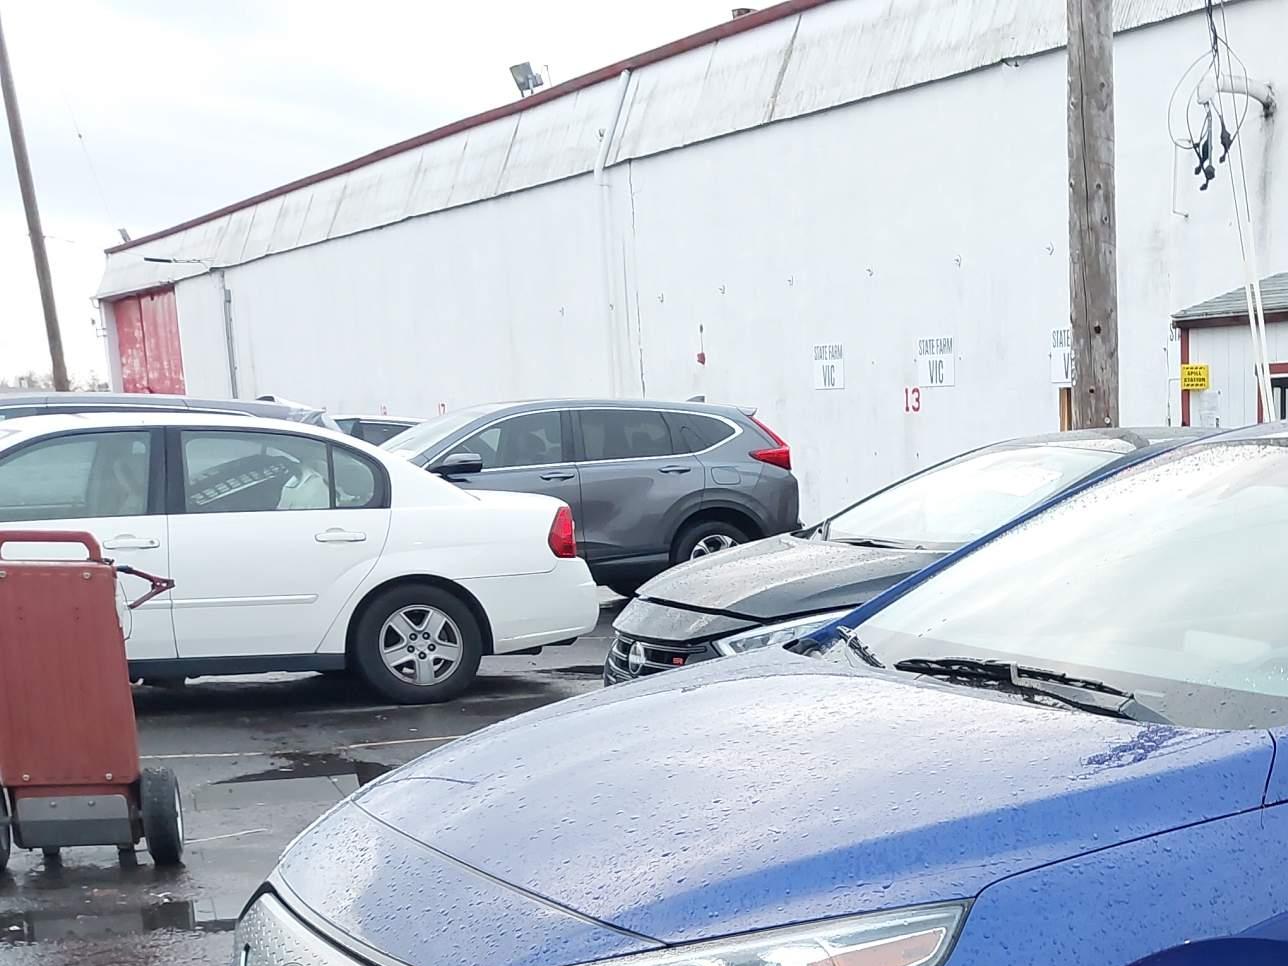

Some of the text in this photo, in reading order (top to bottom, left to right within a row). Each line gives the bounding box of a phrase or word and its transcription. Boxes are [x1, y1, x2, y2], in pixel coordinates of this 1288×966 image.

[918, 337, 953, 355] STATE FARM
[1052, 329, 1071, 348] STATE
[814, 344, 843, 361] STATE FARM
[822, 364, 836, 387] VIC
[928, 359, 944, 384] VIC
[905, 387, 921, 412] 13
